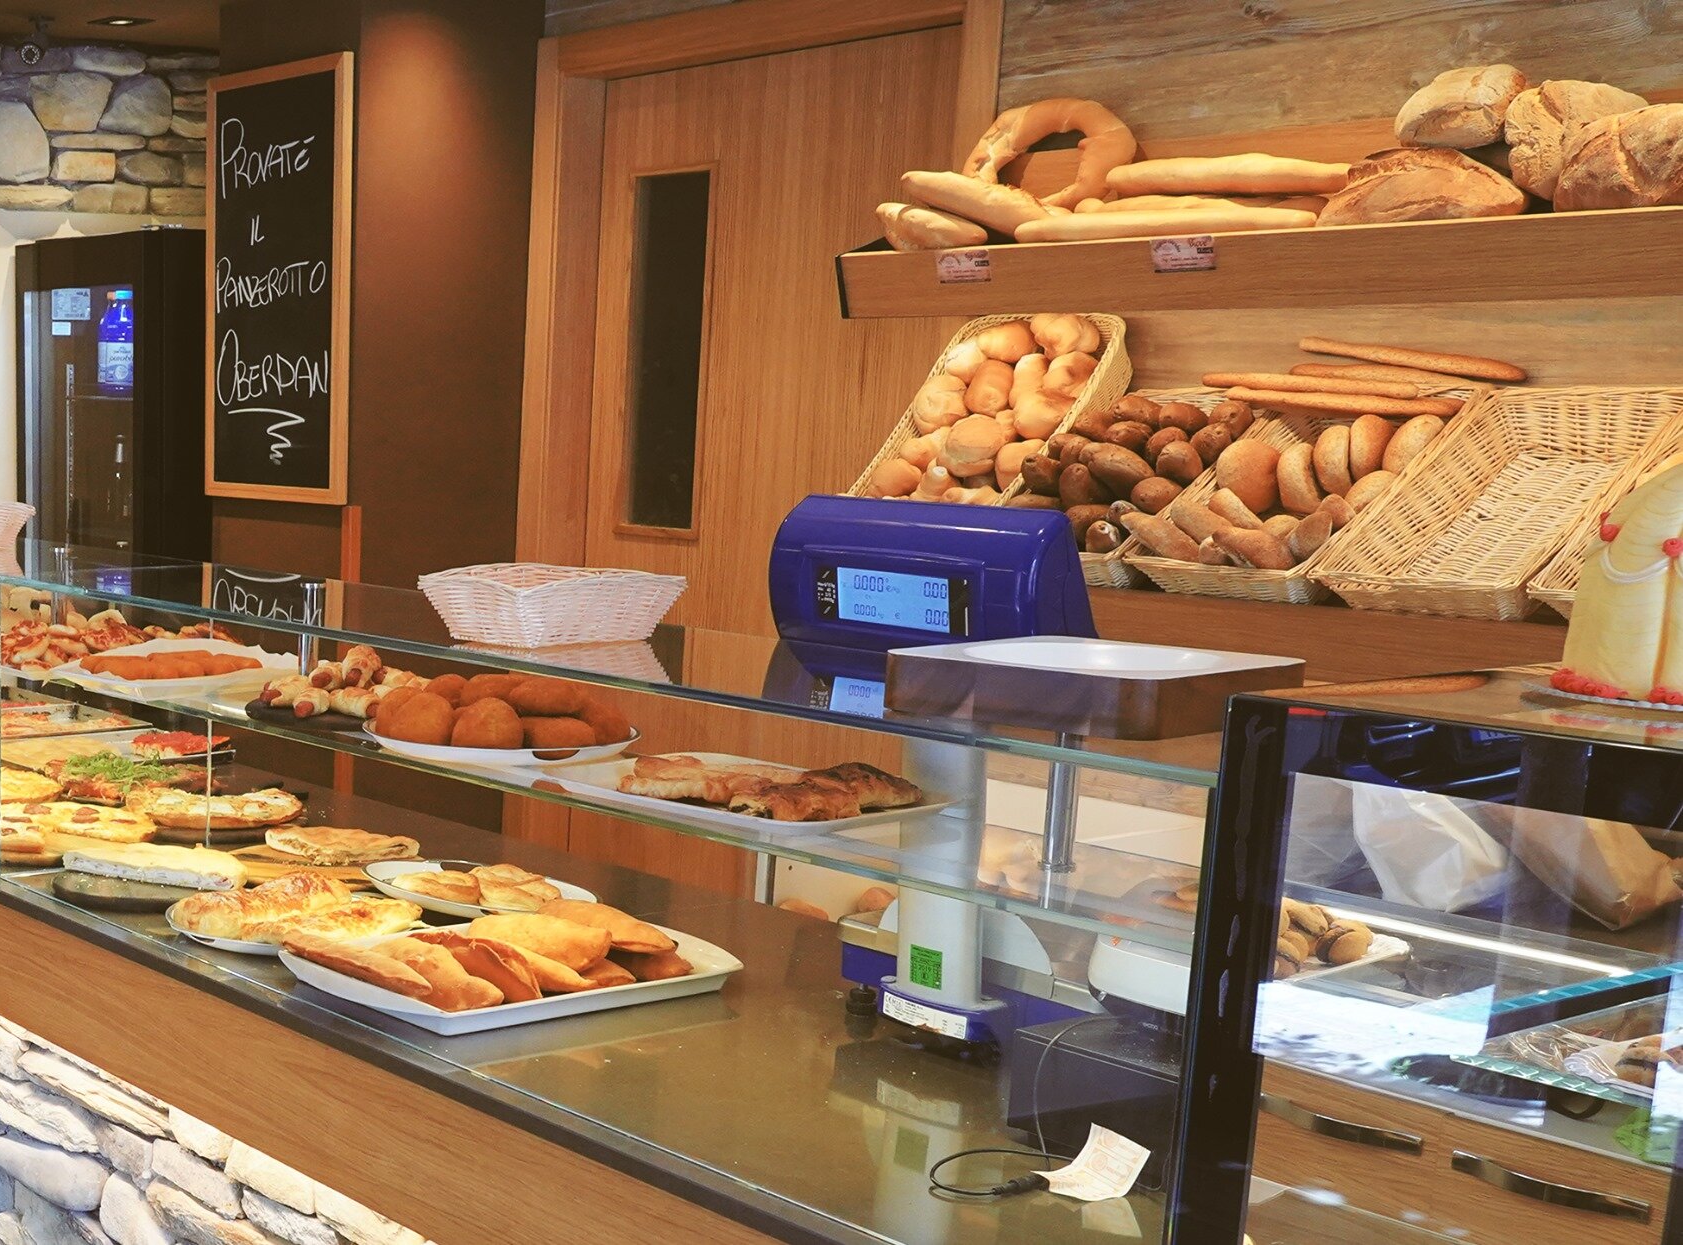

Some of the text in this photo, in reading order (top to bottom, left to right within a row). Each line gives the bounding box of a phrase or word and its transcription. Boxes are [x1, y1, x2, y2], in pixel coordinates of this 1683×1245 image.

[250, 215, 265, 246] IL
[217, 257, 326, 314] PANZEROTTO
[217, 329, 328, 406] OBERDAN
